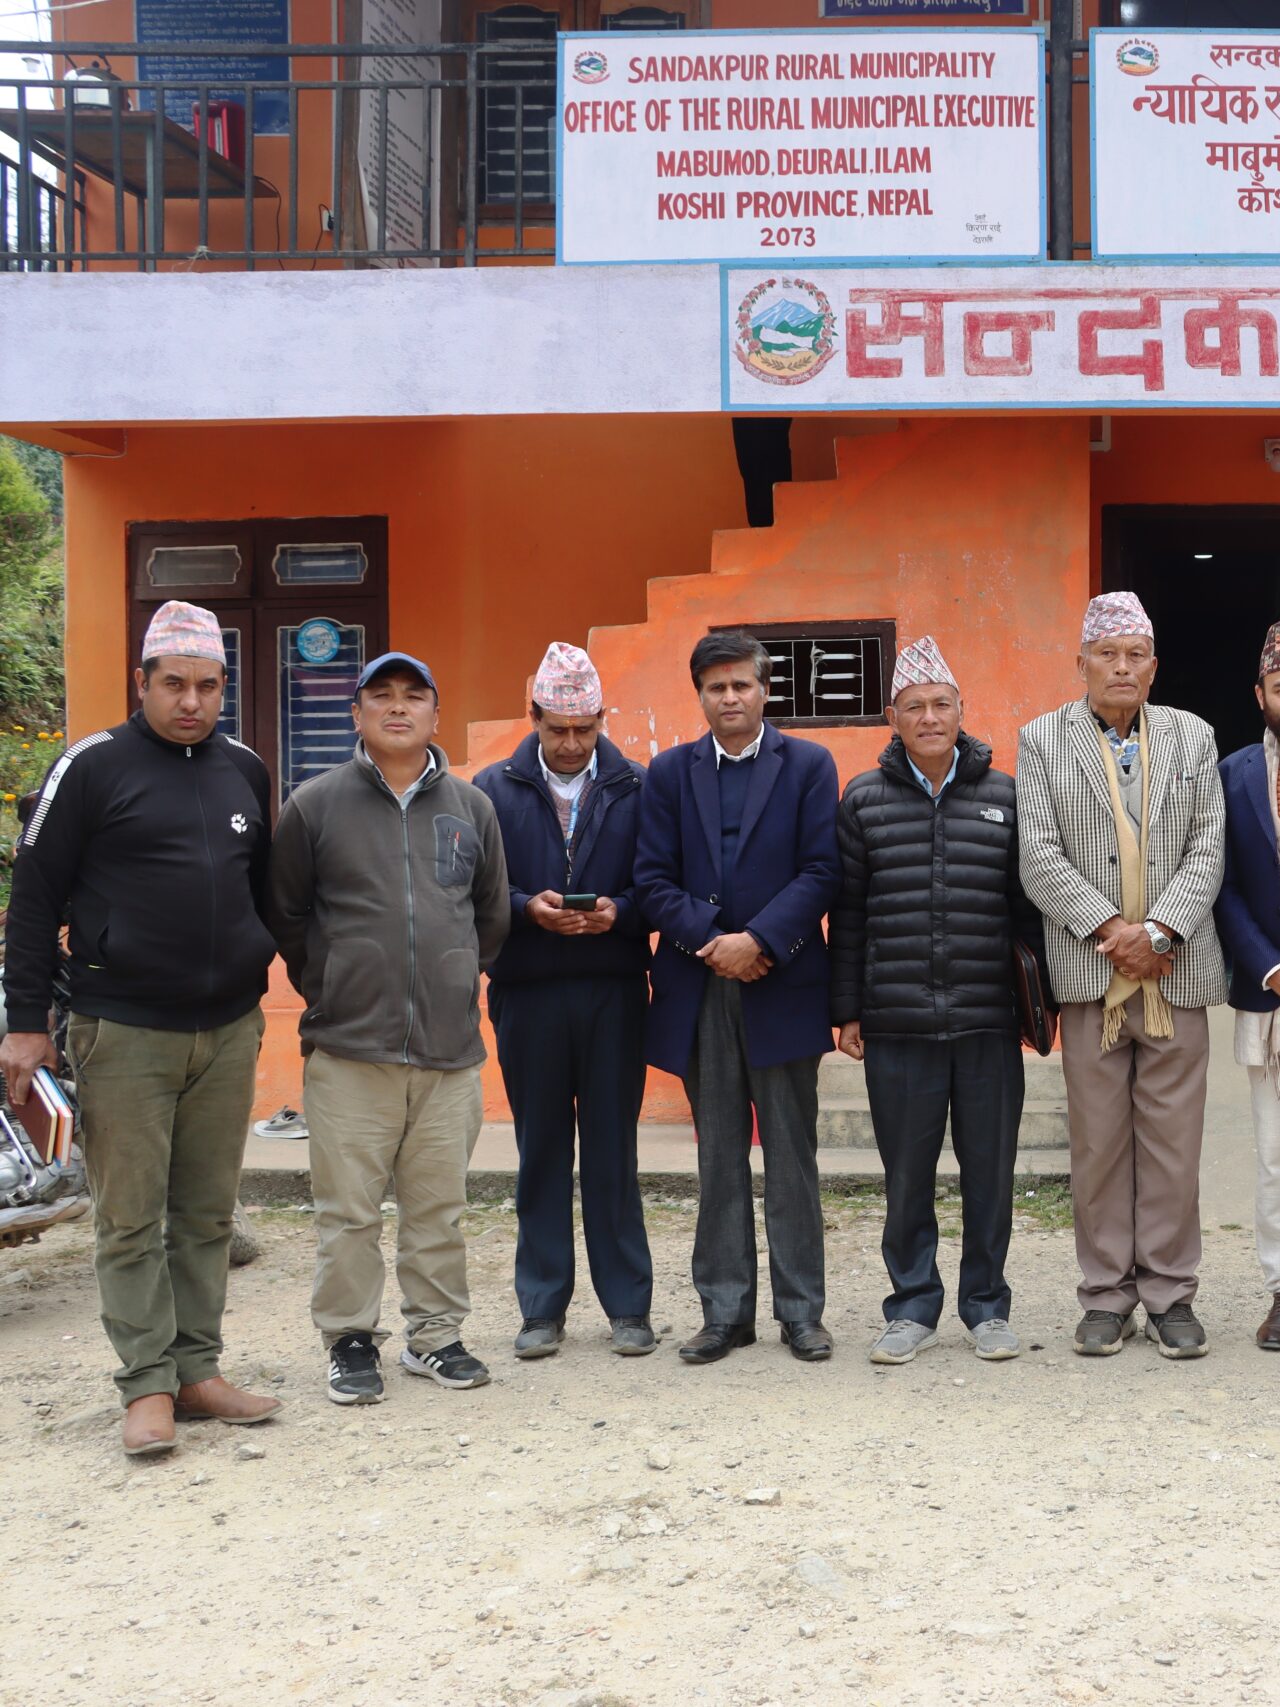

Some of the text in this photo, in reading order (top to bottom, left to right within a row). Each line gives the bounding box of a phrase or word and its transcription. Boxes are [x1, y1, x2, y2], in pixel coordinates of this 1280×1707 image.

[628, 51, 996, 84] SANDAKPUR RURAL MUNICIPALITY
[564, 94, 1035, 133] OFFICE OF THE RURAL MUNICIPAL EXECUTIVE
[1132, 74, 1259, 125] न्यायिक
[657, 192, 726, 220] KOSHI
[867, 188, 934, 216] NEPAL
[760, 227, 817, 248] 2073
